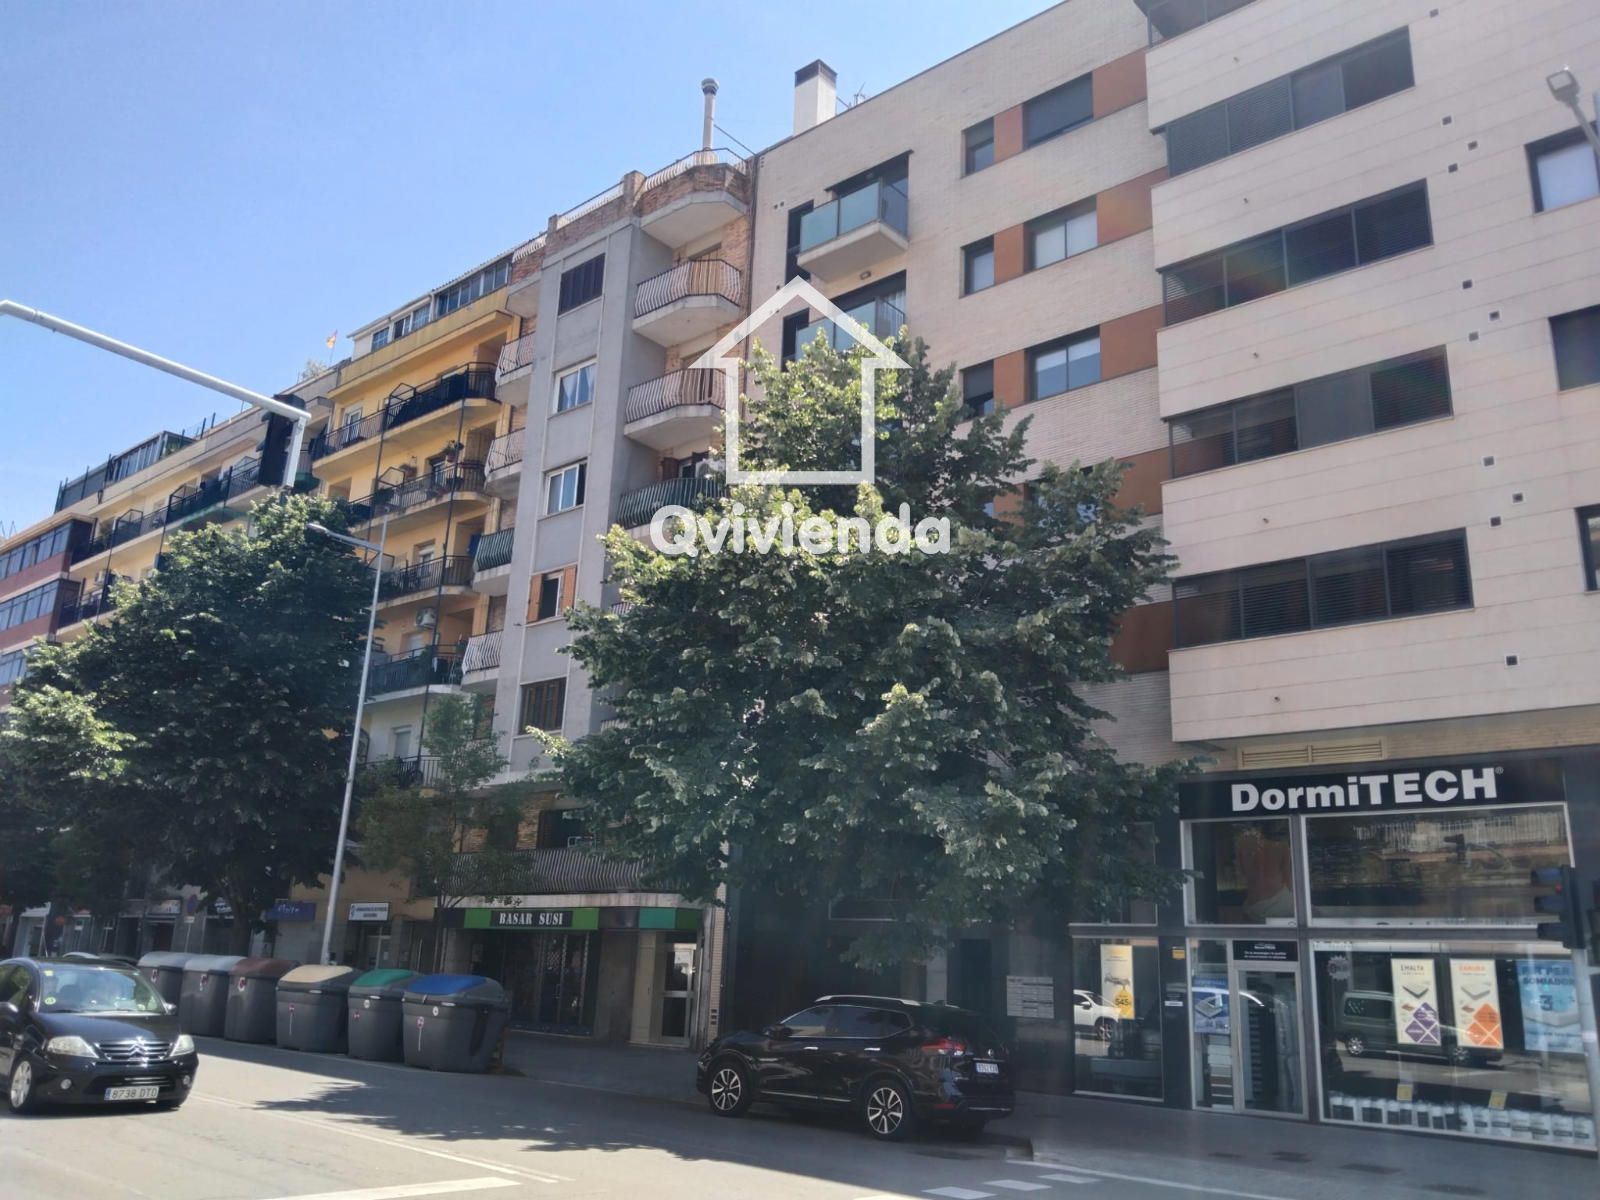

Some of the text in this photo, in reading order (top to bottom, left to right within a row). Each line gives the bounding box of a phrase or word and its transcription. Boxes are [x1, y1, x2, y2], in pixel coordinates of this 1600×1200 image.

[1231, 767, 1497, 812] DormiTECH
[499, 912, 564, 925] BASAR SUSI
[112, 1088, 136, 1099] 8738
